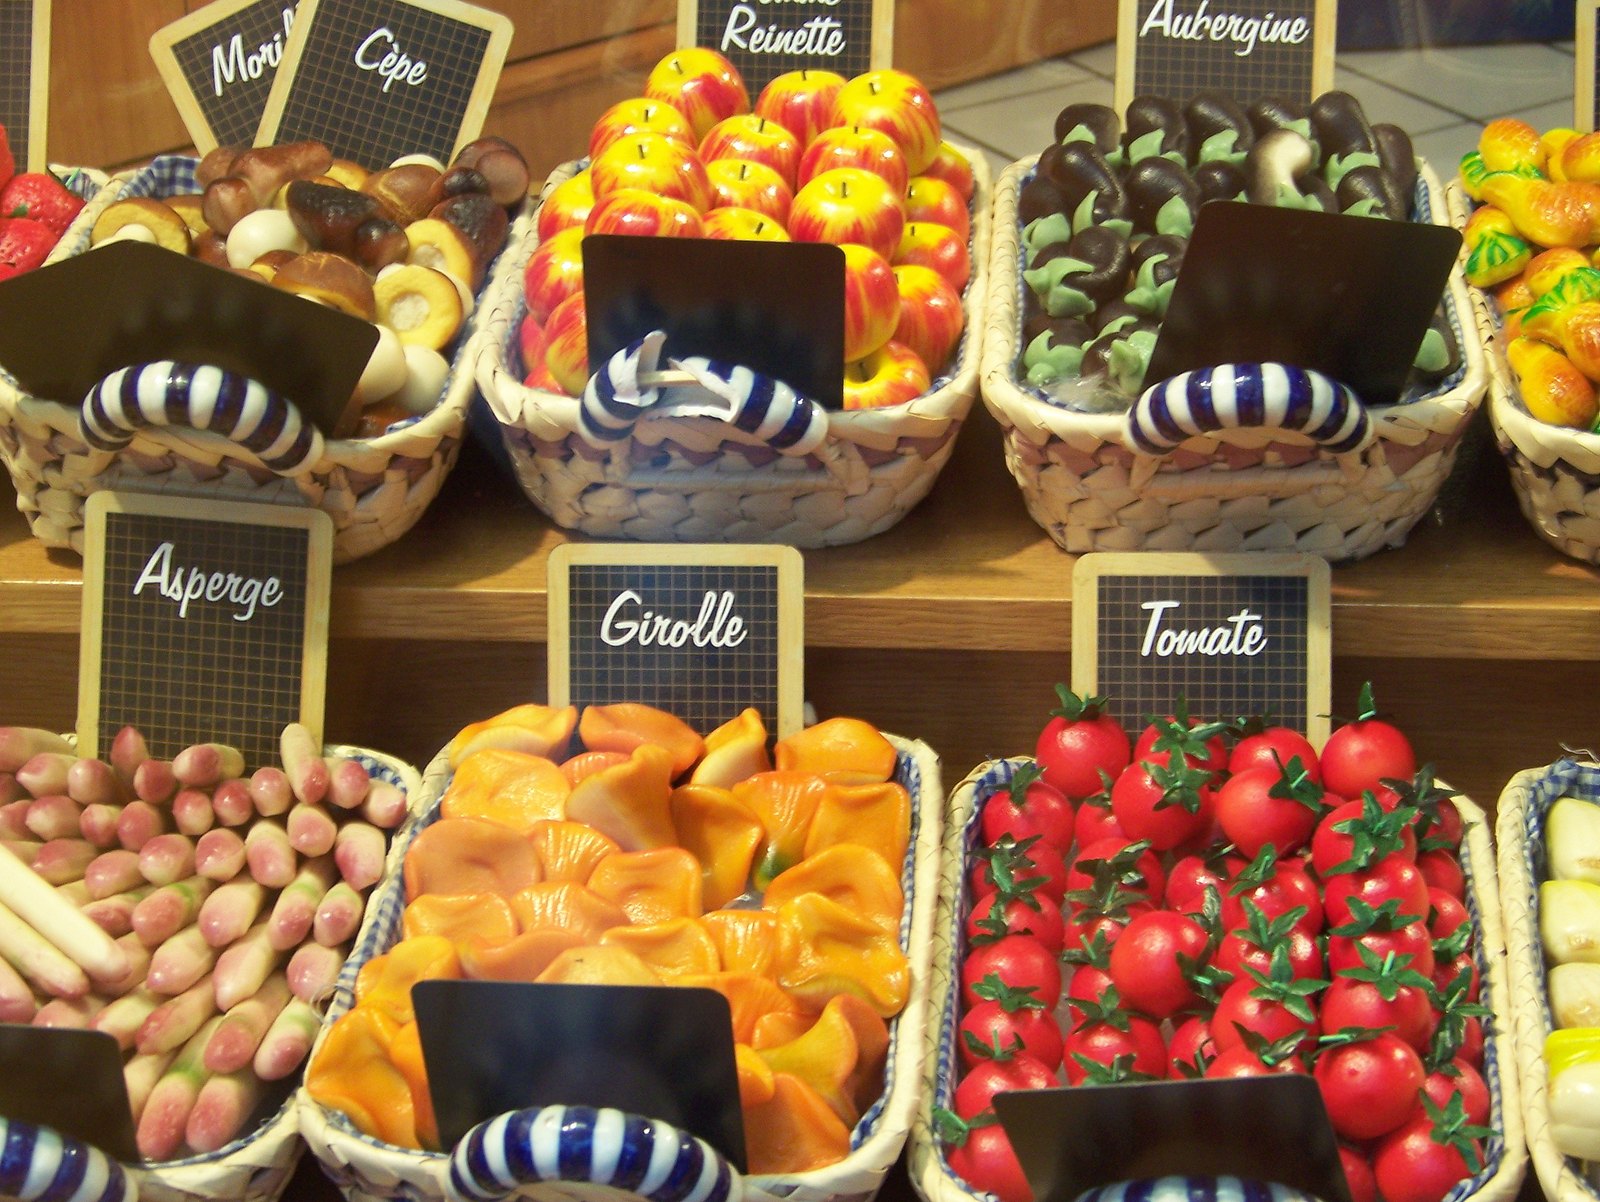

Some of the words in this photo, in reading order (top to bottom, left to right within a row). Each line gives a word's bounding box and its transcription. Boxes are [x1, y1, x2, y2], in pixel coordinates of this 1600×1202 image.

[212, 1, 299, 97] Moril
[720, 4, 847, 56] Reinette
[1138, 0, 1310, 57] Aubergine
[354, 27, 428, 93] Cèpe
[133, 542, 284, 621] Asperge
[600, 590, 748, 648] Girolle
[1141, 600, 1268, 657] Tomate
